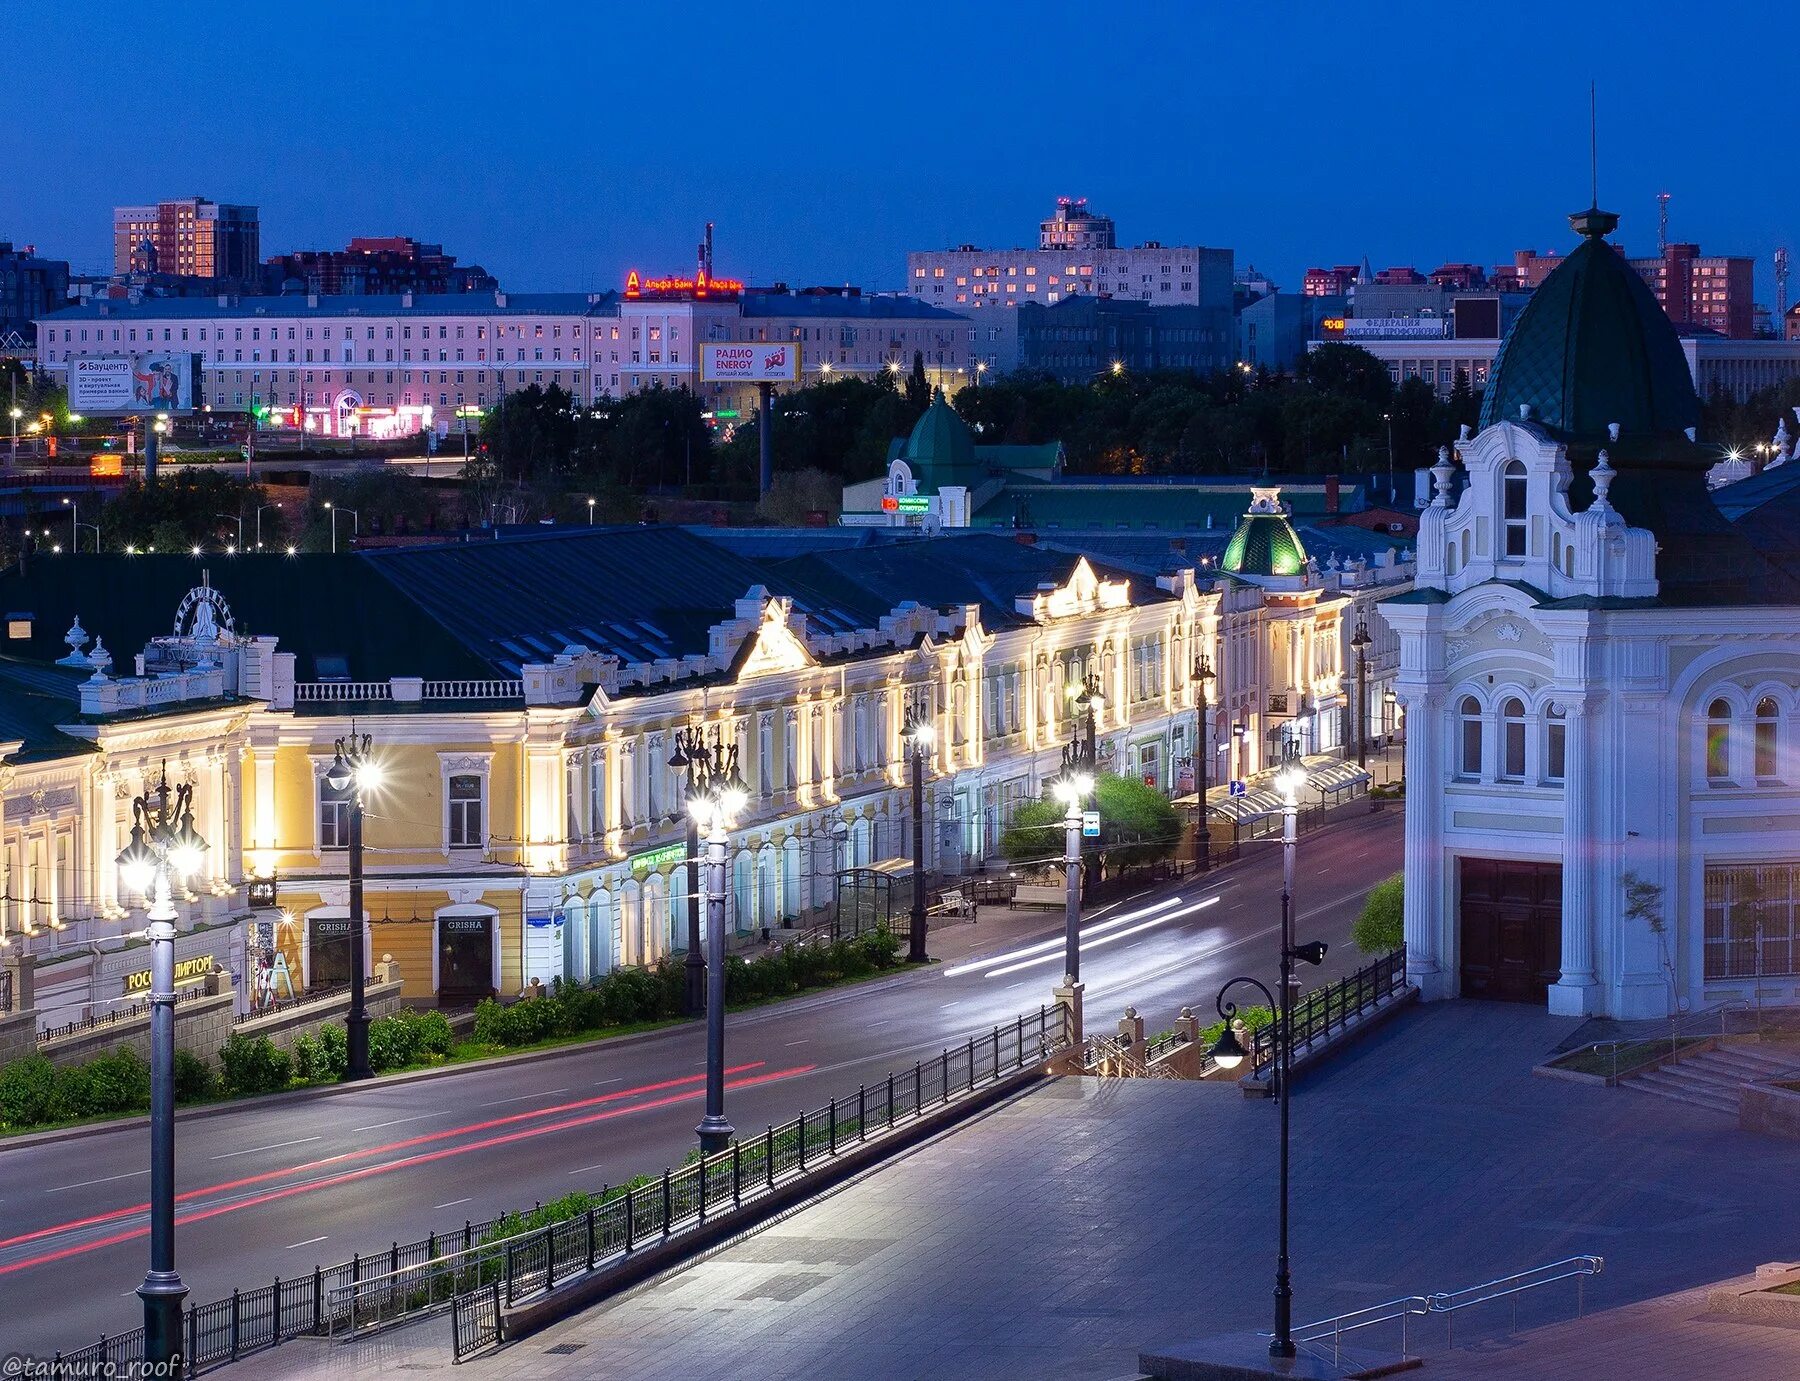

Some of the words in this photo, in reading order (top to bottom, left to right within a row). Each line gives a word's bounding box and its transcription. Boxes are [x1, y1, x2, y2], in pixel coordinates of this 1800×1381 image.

[1366, 319, 1420, 327] ФЕДЕРАЦИЯ
[1345, 328, 1380, 336] ОМСКИХ
[1384, 328, 1442, 336] ПРОФСОЮЗОВ
[716, 349, 753, 359] РАДИО
[88, 361, 129, 372] Бауцентр
[716, 360, 753, 369] ENERGY
[448, 921, 482, 930] GRISHA
